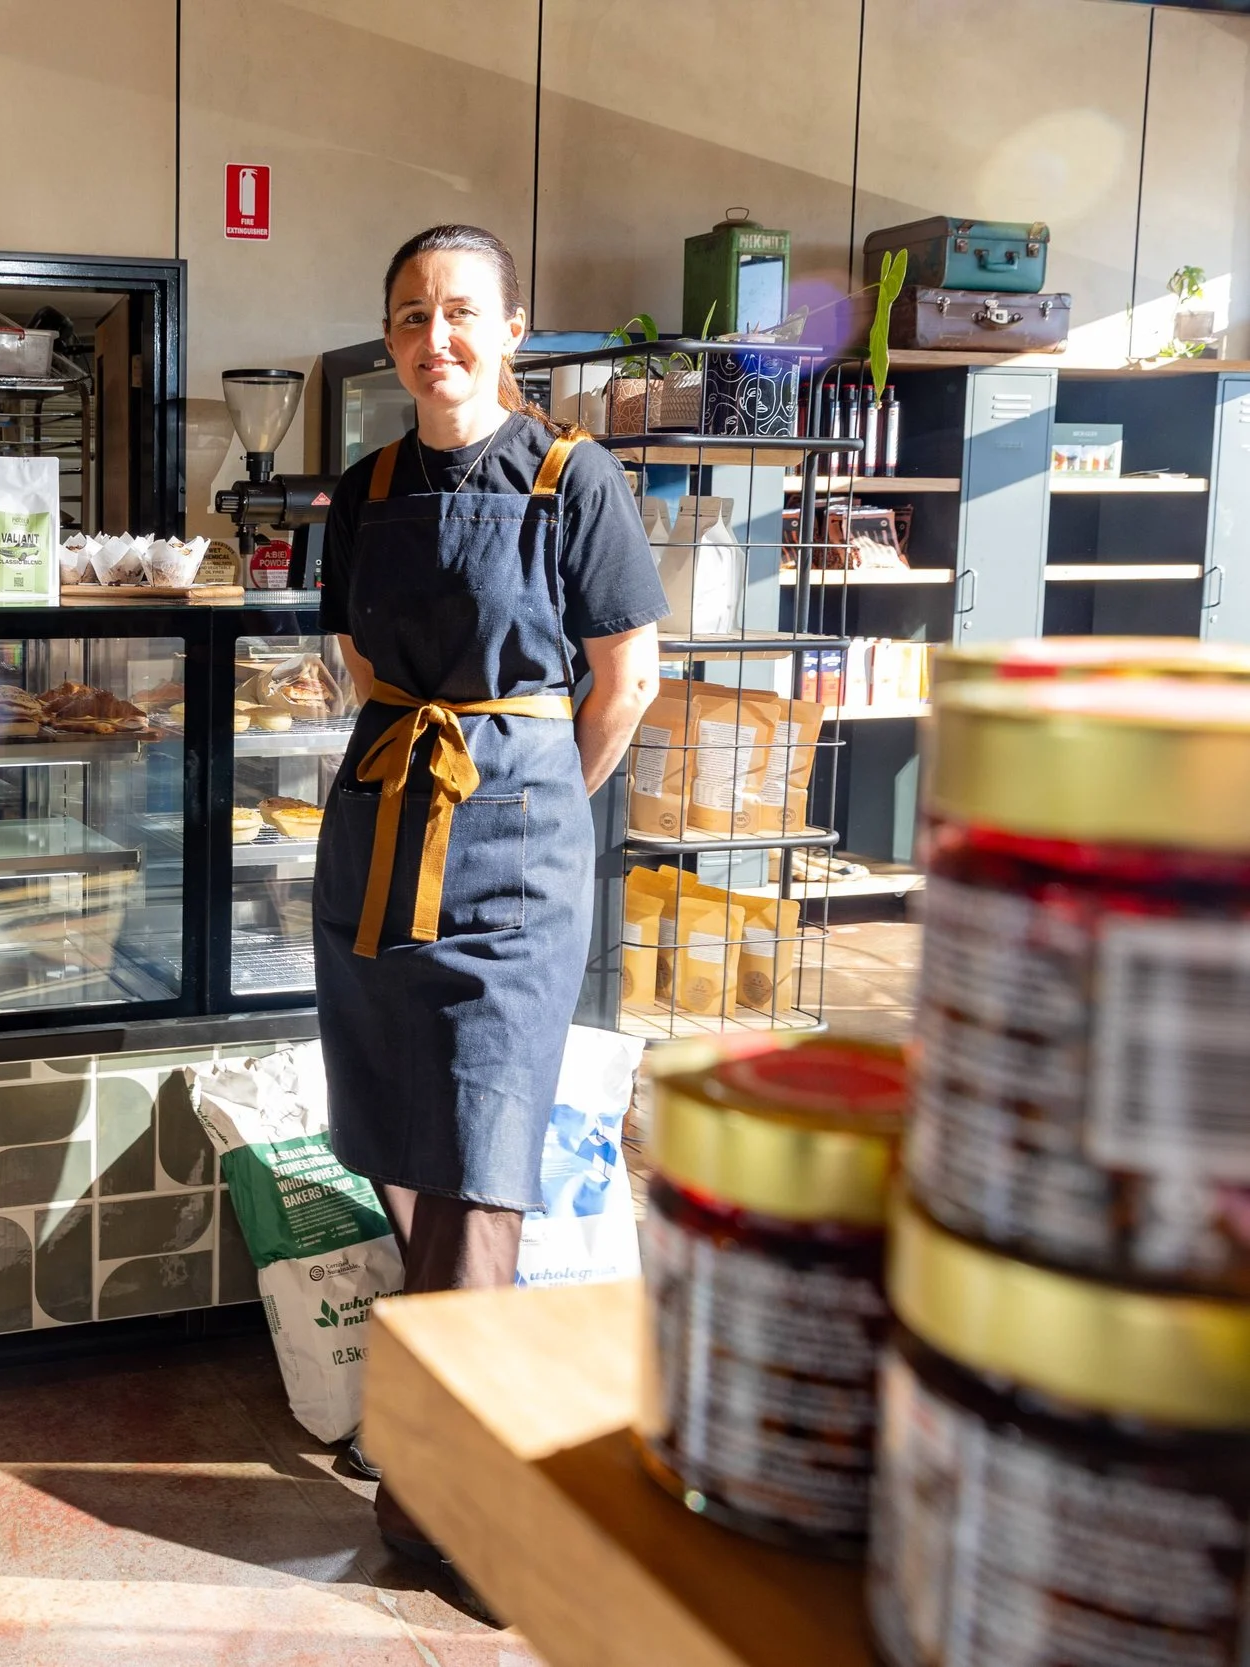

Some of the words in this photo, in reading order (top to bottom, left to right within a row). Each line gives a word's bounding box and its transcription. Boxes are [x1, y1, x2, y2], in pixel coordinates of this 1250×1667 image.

[1, 532, 40, 544] VALIANT
[276, 1165, 345, 1193] WHOLEWHEAT
[281, 1186, 323, 1209] BAKERS
[323, 1176, 356, 1196] FLOUR
[325, 1258, 350, 1269] Certified
